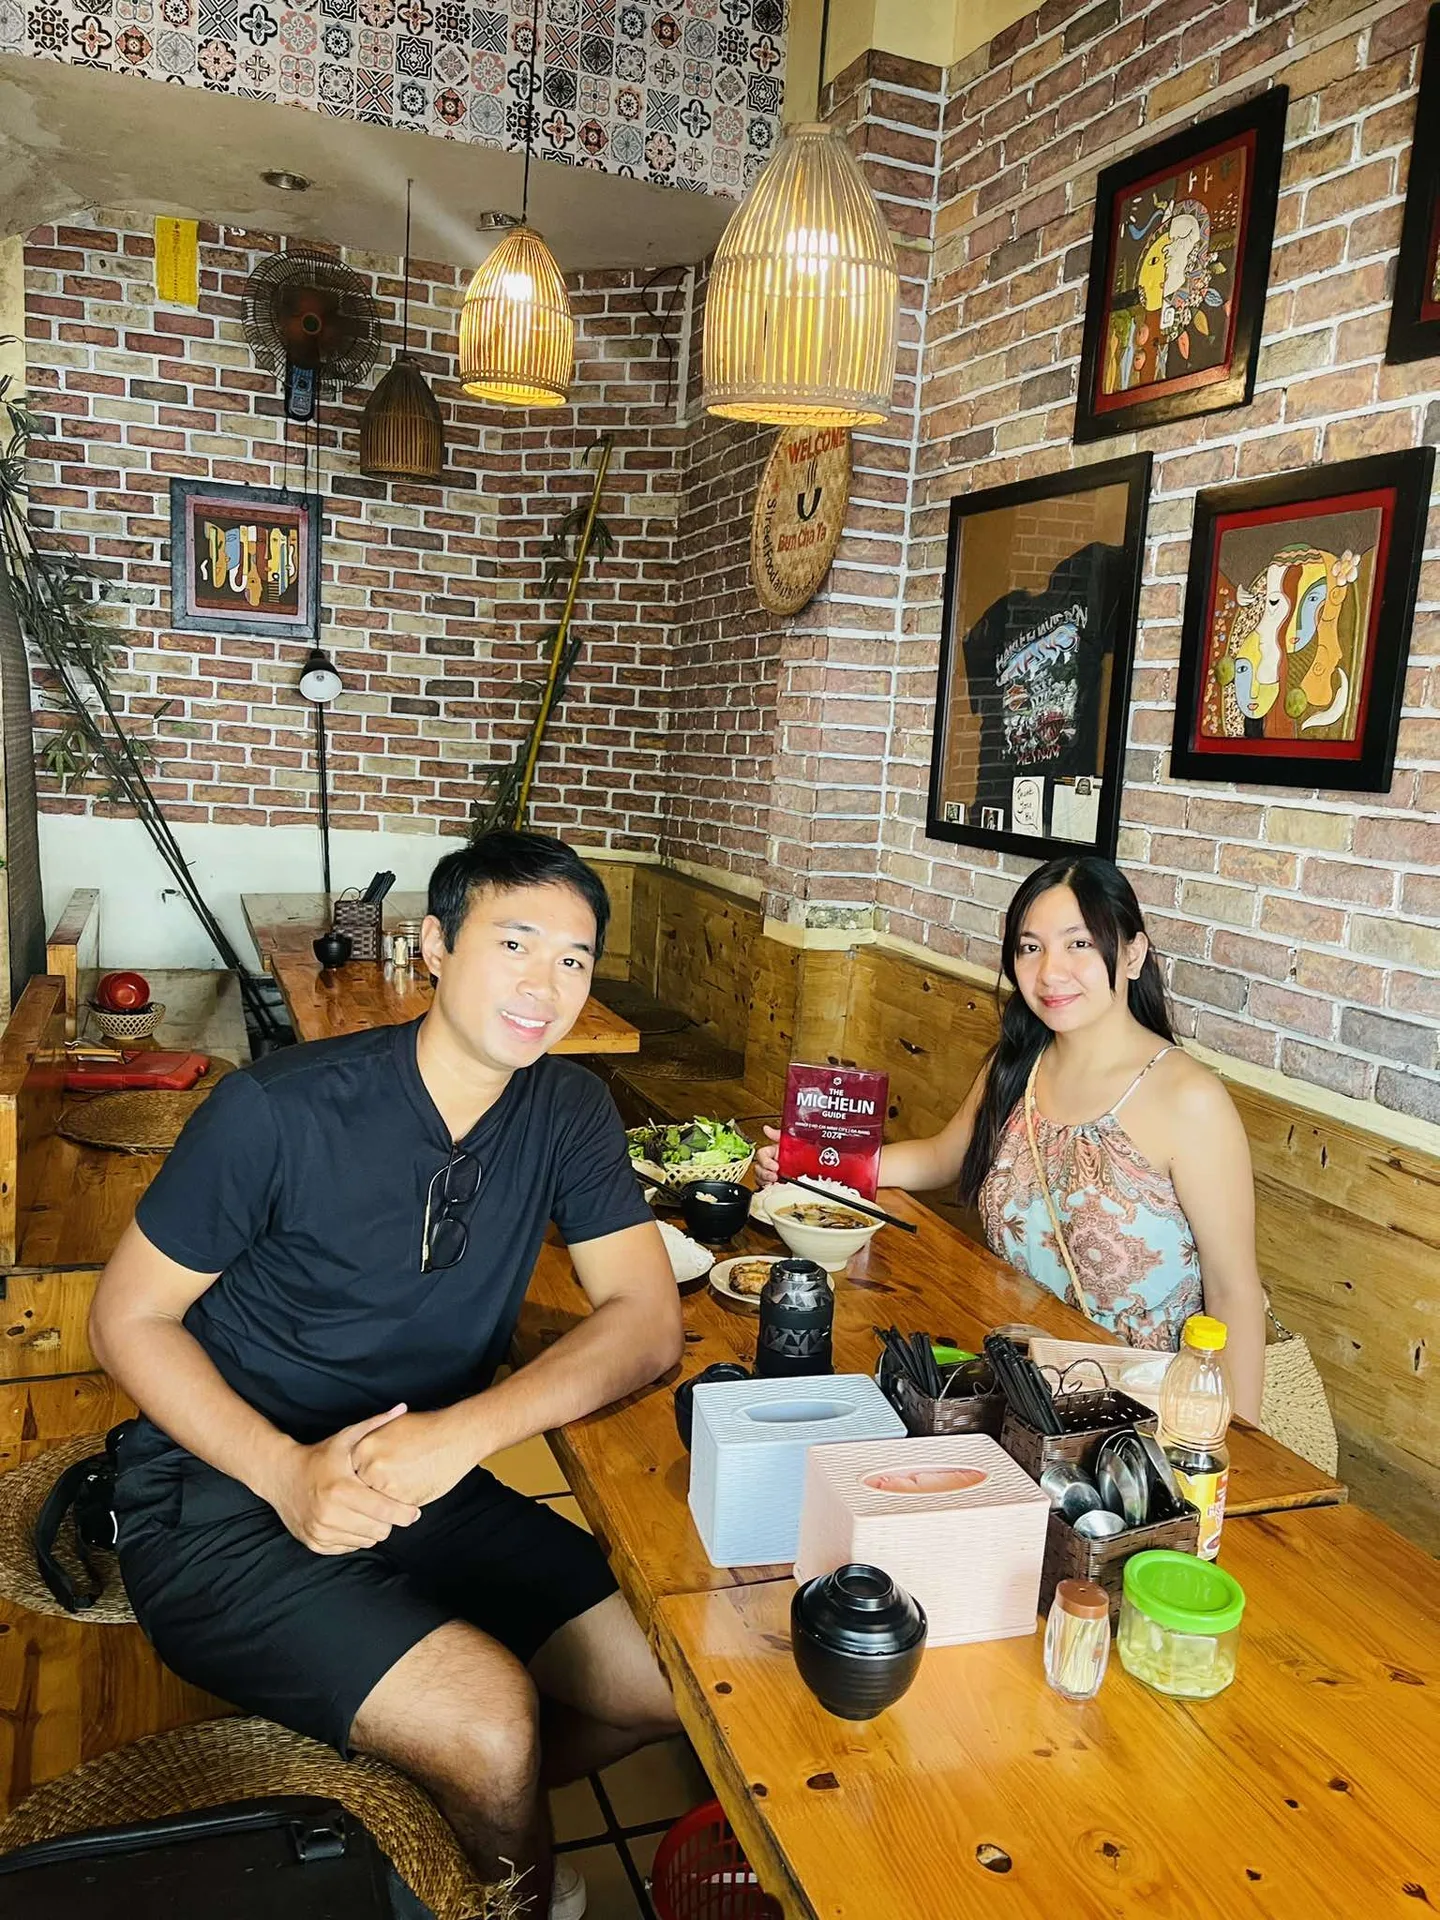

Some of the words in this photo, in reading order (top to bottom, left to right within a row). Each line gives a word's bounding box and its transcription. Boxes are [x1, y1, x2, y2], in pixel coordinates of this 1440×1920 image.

[787, 427, 845, 464] WELCOME
[764, 548, 780, 585] Food
[829, 1088, 844, 1097] THE
[796, 1092, 875, 1115] MICHELIN
[821, 1110, 847, 1120] GUIDE
[821, 1130, 842, 1140] 2024
